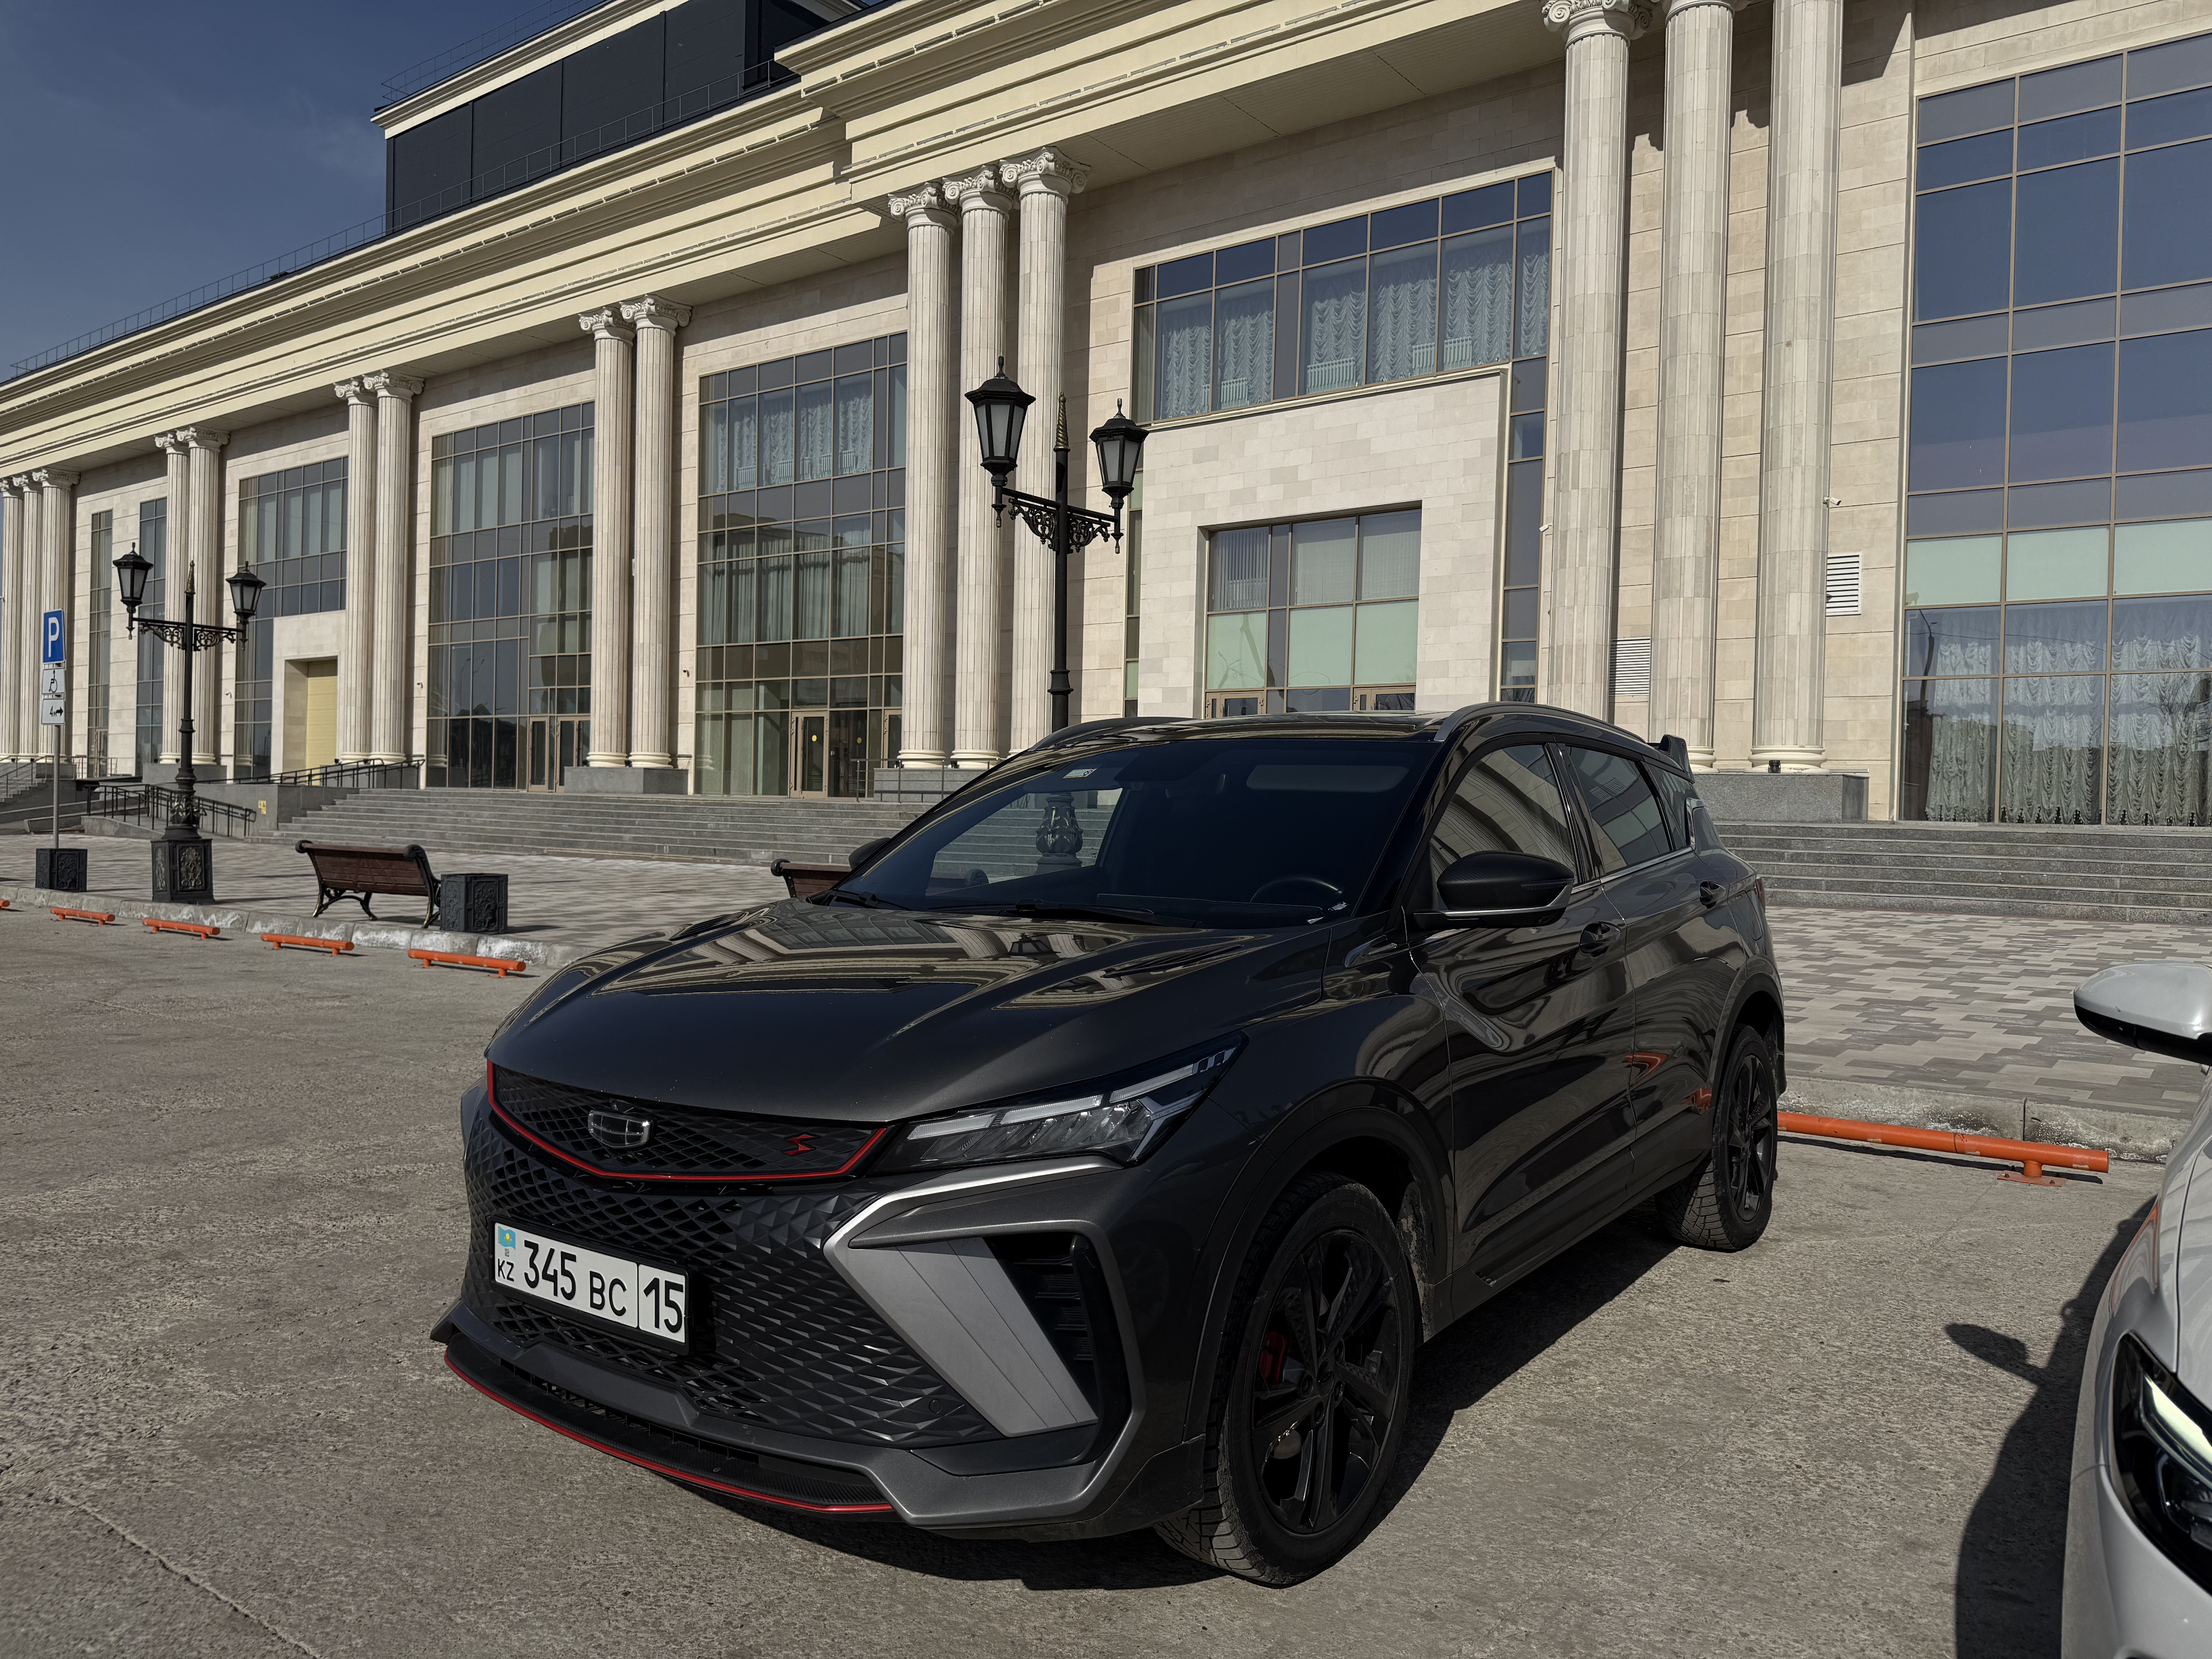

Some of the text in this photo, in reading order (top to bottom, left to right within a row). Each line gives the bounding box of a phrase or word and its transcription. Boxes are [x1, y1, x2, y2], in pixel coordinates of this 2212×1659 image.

[48, 617, 59, 657] P
[498, 1258, 514, 1282] KZ
[524, 1240, 684, 1333] 345 BC 15
